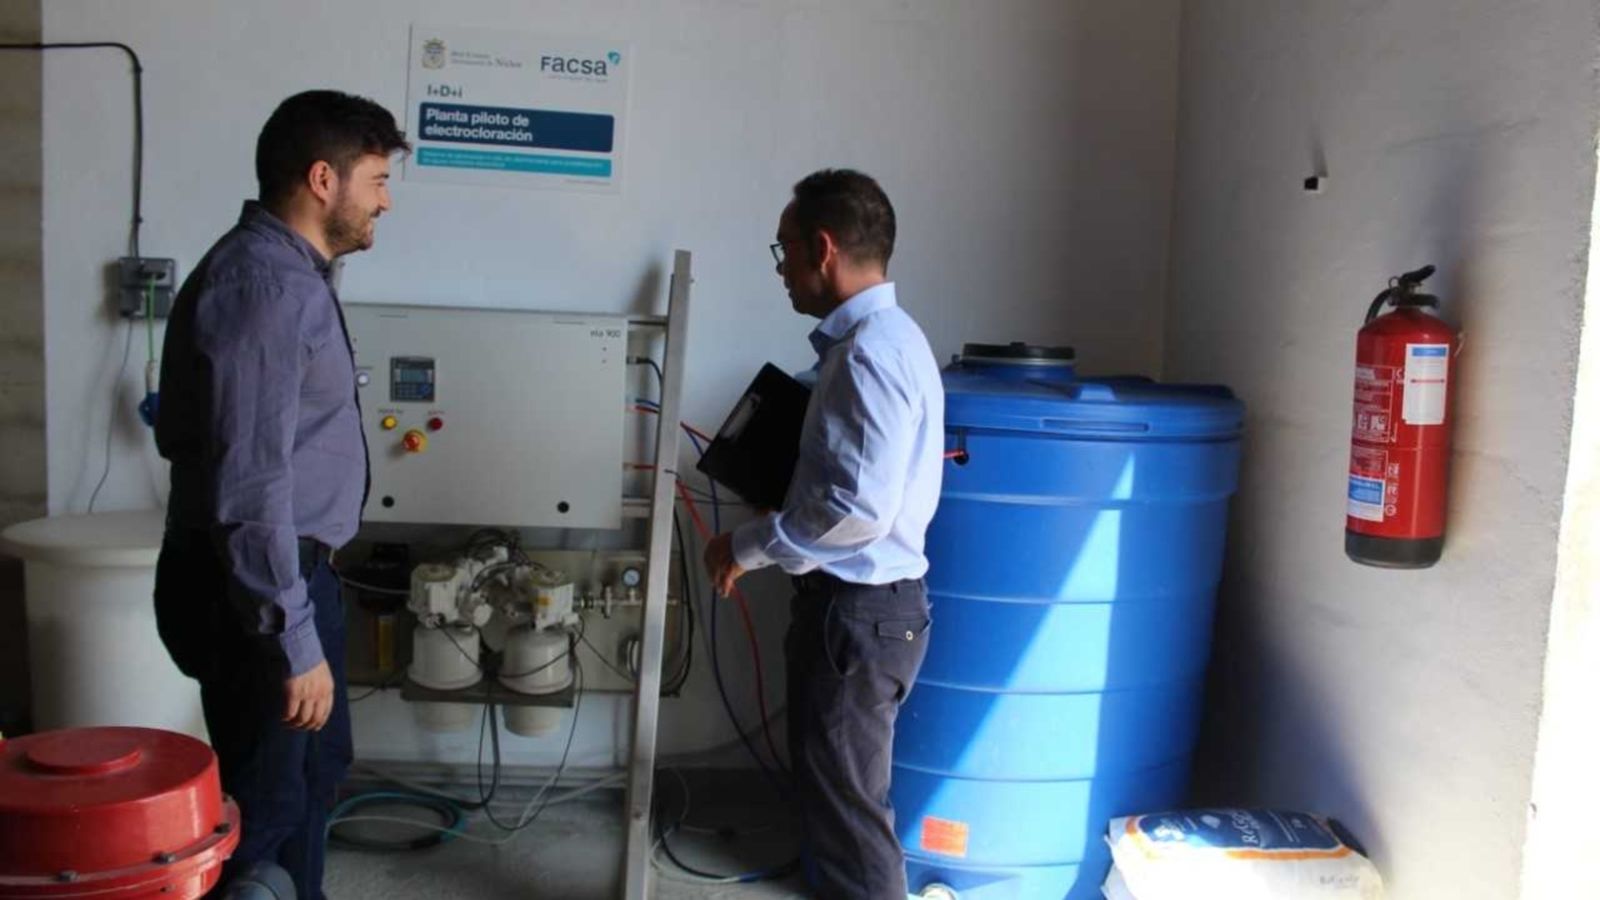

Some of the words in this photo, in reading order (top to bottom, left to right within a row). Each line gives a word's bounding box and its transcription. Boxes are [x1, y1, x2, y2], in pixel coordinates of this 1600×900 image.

[427, 84, 463, 98] I+D+i
[425, 108, 468, 123] Planta
[471, 111, 510, 127] piloto
[512, 113, 530, 127] de
[424, 124, 533, 142] electrocloración
